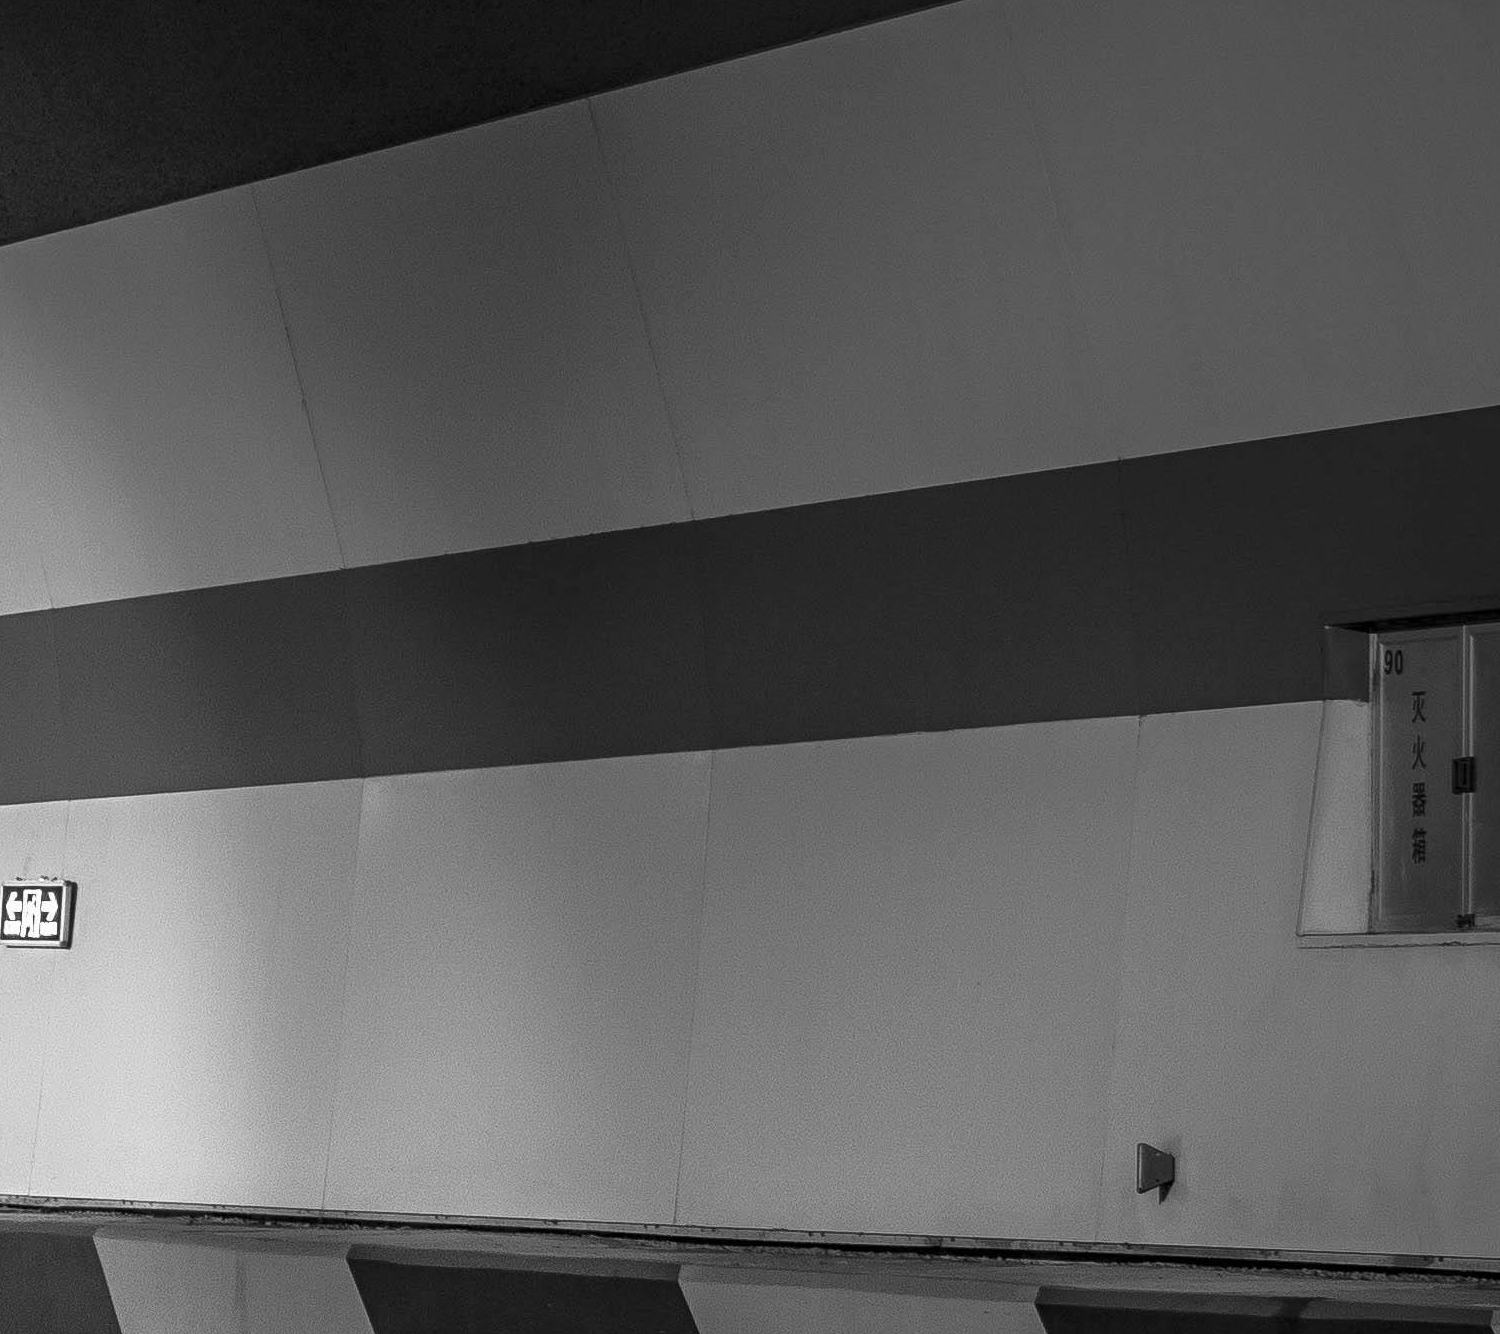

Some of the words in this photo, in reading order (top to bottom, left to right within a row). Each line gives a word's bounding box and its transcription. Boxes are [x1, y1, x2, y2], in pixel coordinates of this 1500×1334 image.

[1384, 649, 1404, 676] 90
[1411, 691, 1427, 864] 灭火器箱
